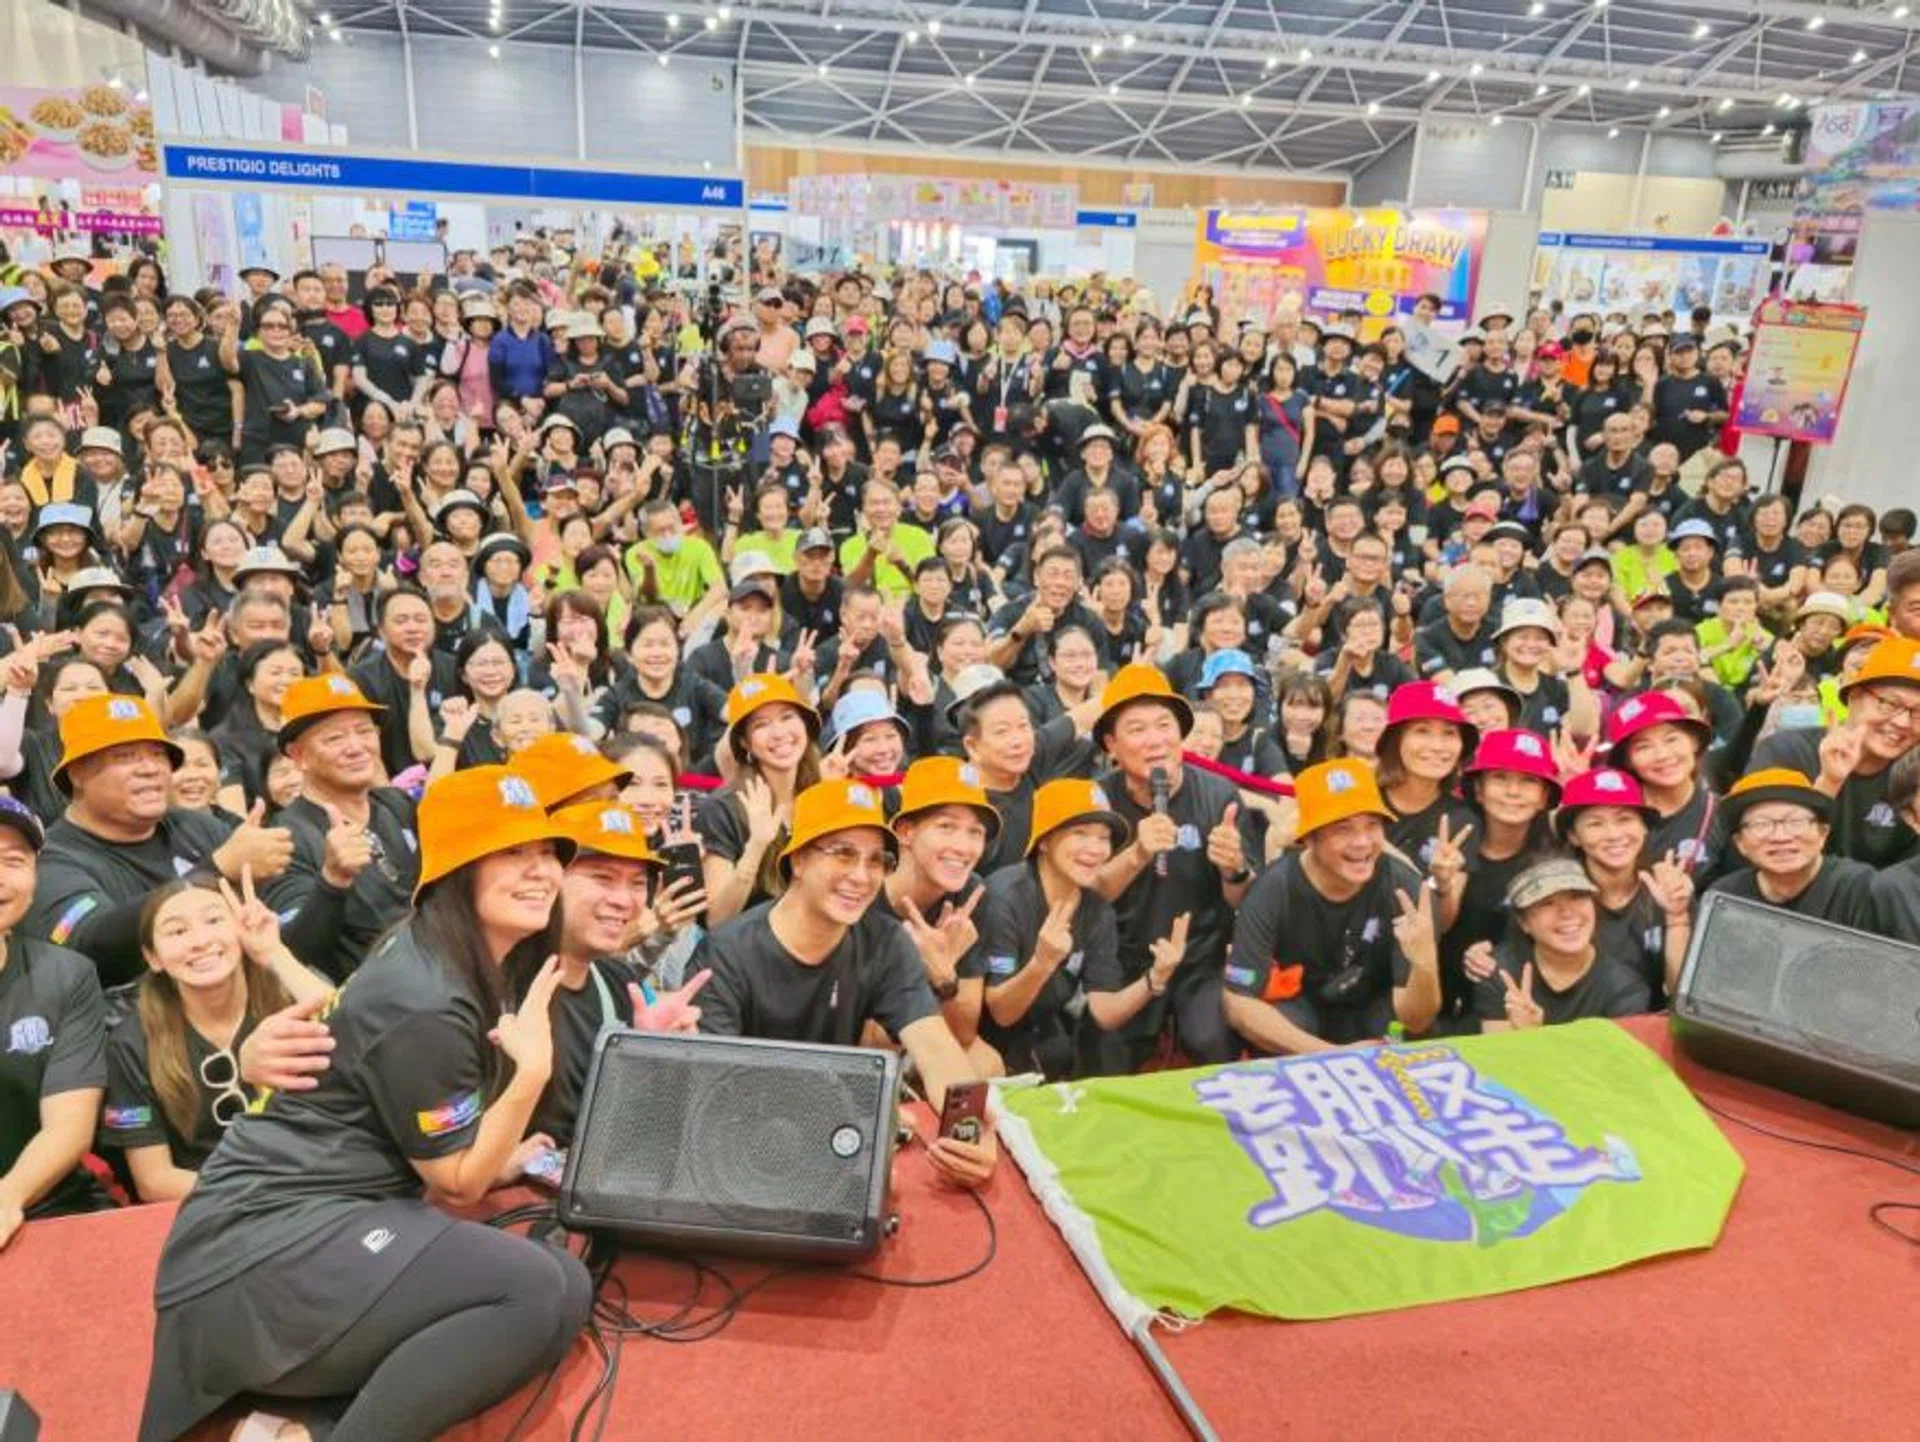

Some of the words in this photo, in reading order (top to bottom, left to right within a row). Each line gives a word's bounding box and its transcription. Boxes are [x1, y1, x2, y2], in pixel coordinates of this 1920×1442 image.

[187, 155, 265, 174] PRESTIGIO
[269, 160, 341, 178] DELIGHTS
[1324, 229, 1388, 257] LUCKY
[1394, 227, 1464, 264] DRAW
